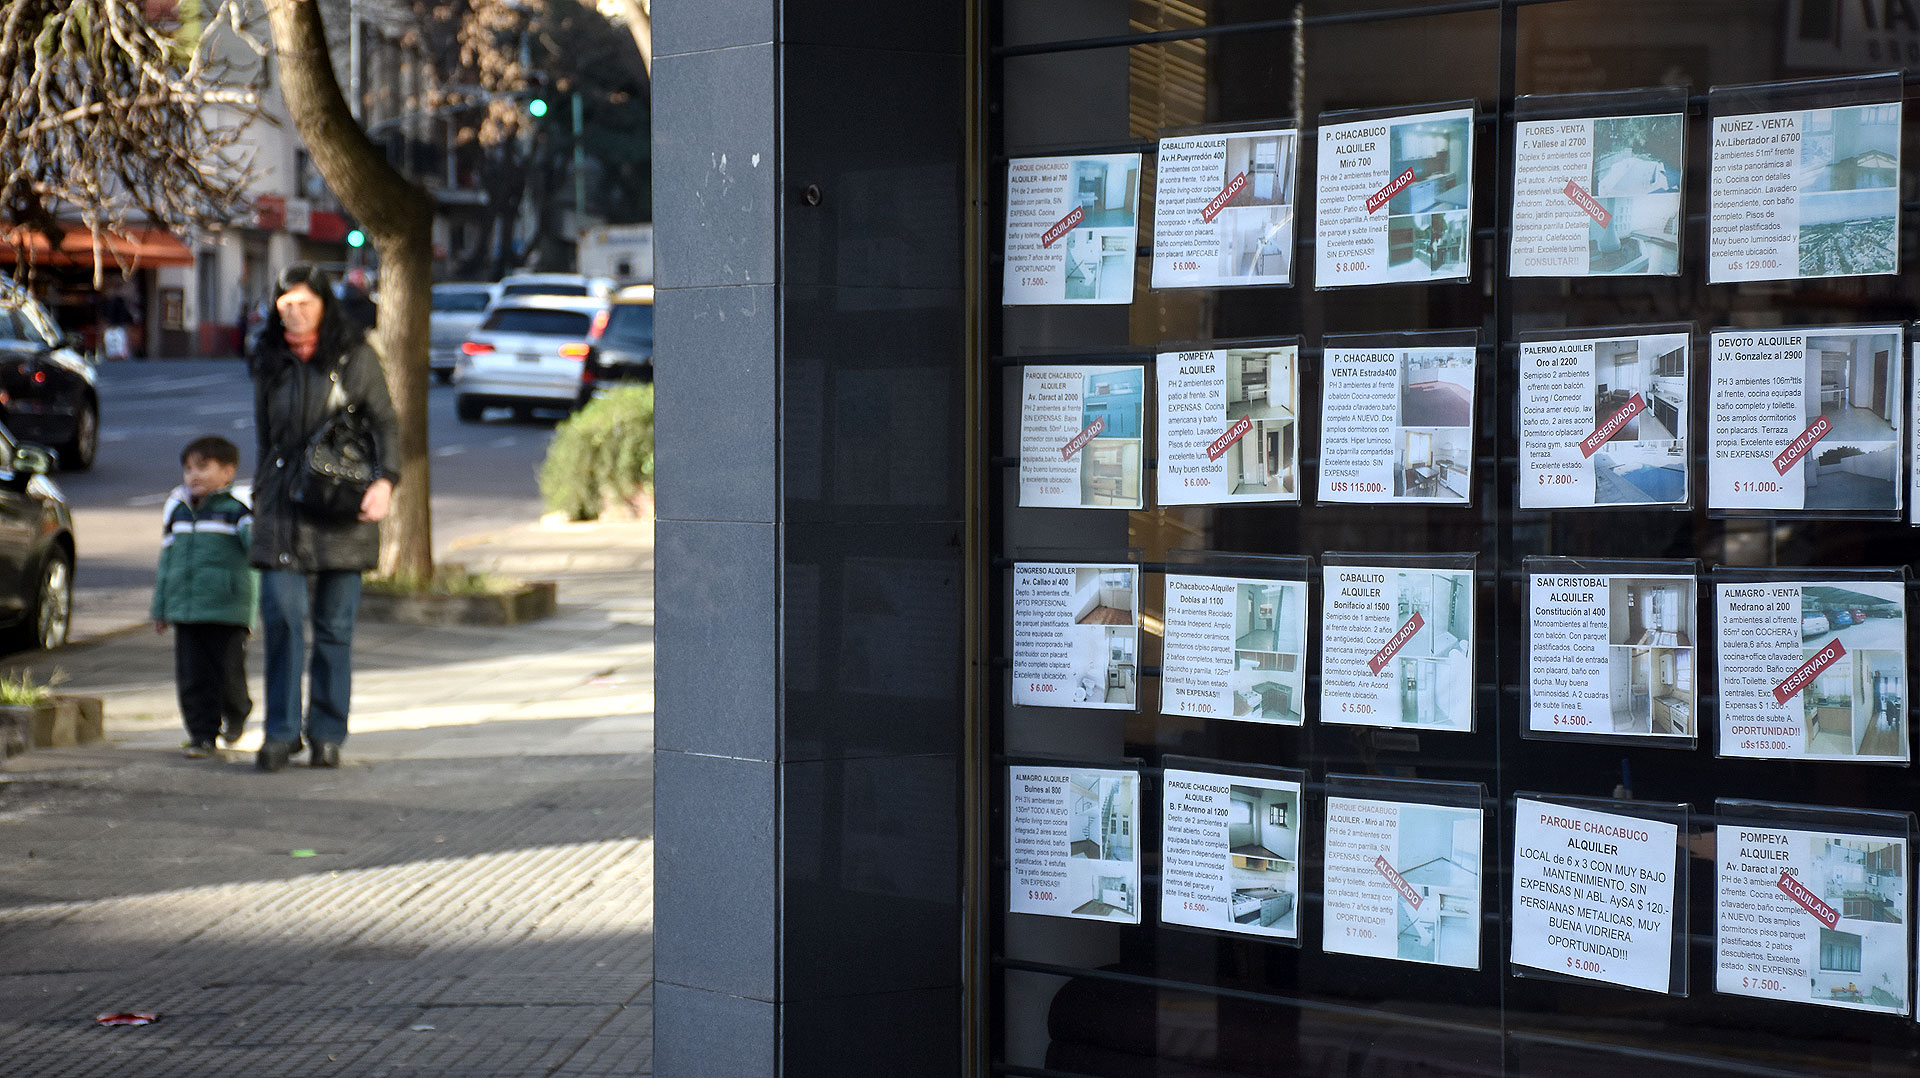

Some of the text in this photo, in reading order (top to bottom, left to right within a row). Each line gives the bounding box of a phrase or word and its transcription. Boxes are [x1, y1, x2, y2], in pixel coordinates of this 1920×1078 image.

[1526, 127, 1554, 136] FLORES
[1561, 125, 1585, 133] VENTA
[1720, 120, 1753, 132] NUÑEZ
[1762, 118, 1794, 129] VENTA
[1335, 127, 1386, 140] CHACABUCO
[1532, 139, 1558, 148] Vallese
[1569, 137, 1586, 146] 2700
[1715, 137, 1769, 147] Av.Libertador
[1781, 133, 1800, 142] 6700
[1336, 142, 1375, 154] ALQUILER
[1720, 150, 1754, 159] ambientes
[1775, 148, 1794, 156] frente
[1358, 157, 1371, 166] 700
[1367, 171, 1413, 209] ALQUILADO
[1204, 177, 1244, 218] ALQUILADO
[1572, 187, 1605, 222] VENDIDO
[1043, 210, 1082, 243] ALQUILADO
[1712, 224, 1738, 235] parquet
[1173, 262, 1177, 270] $
[1336, 263, 1340, 272] $
[1719, 337, 1802, 347] DEVOTO ALQUILER
[1559, 345, 1593, 353] ALQUILER
[1179, 352, 1214, 361] POMPEYA
[1344, 354, 1394, 362] CHACABUCO
[1718, 352, 1733, 361] J.V.
[1735, 352, 1772, 360] Gonzalez
[1784, 351, 1802, 359] 2900
[1536, 359, 1550, 367] Oro
[1560, 357, 1578, 366] 2200
[1180, 365, 1215, 374] ALQUILER
[1732, 415, 1757, 423] amplios
[1588, 402, 1636, 448] RESERVADO
[1066, 422, 1102, 456] ALQUILADO
[1210, 420, 1249, 456] ALQUILADO
[1778, 419, 1828, 469] ALQUILADO
[1169, 465, 1182, 475] Muy
[1184, 478, 1188, 486] $
[1539, 475, 1544, 485] $
[1350, 483, 1386, 492] 115.000.-
[1734, 482, 1783, 492] $ 11.000.-
[1340, 573, 1384, 583] CABALLITO
[1537, 578, 1607, 587] SAN CRISTOBAL
[1341, 588, 1380, 597] ALQUILER
[1550, 593, 1594, 602] ALQUILER
[1724, 589, 1765, 597] ALMAGRO
[1772, 589, 1799, 597] VENTA
[1334, 601, 1365, 610] Bonifacio
[1535, 607, 1582, 615] Constitución
[1376, 622, 1416, 666] ALQUILADO
[1781, 648, 1835, 694] RESERVADO
[1031, 684, 1034, 692] $
[1181, 702, 1184, 711] $
[1342, 703, 1347, 713] $
[1554, 714, 1592, 726] $ 4.500.-
[1732, 726, 1801, 736] OPORTUNIDAD!!
[1331, 802, 1397, 815] PARQUE CHACABUCO
[1540, 815, 1649, 842] PARQUE CHACABUCO
[1740, 832, 1788, 845] POMPEYA
[1568, 838, 1618, 855] ALQUILER
[1740, 848, 1789, 861] ALQUILER
[1520, 847, 1550, 862] LOCAL
[1553, 854, 1564, 864] de
[1566, 856, 1573, 866] 6
[1582, 859, 1588, 868] 3
[1590, 860, 1613, 873] CON
[1614, 864, 1638, 878] MUY
[1640, 869, 1666, 883] BAJO
[1726, 862, 1739, 871] Av.
[1742, 863, 1768, 873] Daract
[1780, 867, 1799, 876] 2200
[1378, 861, 1418, 905] ALQUILADO
[1543, 867, 1646, 895] MANTENIMIENTO. SIN
[1521, 878, 1669, 915] EXPENSAS NI ABL. AySA $ 120.-
[1782, 878, 1836, 923] ALQUILADO
[1520, 896, 1575, 915] PERSIANAS
[1638, 919, 1661, 932] MUY
[1346, 927, 1350, 936] $
[1549, 917, 1633, 943] BUENA VIDRIERA.
[1548, 935, 1628, 960] OPORTUNIDAD!!!
[1567, 956, 1606, 973] $ 5.000.-
[1742, 977, 1786, 992] $ 7.500.-
